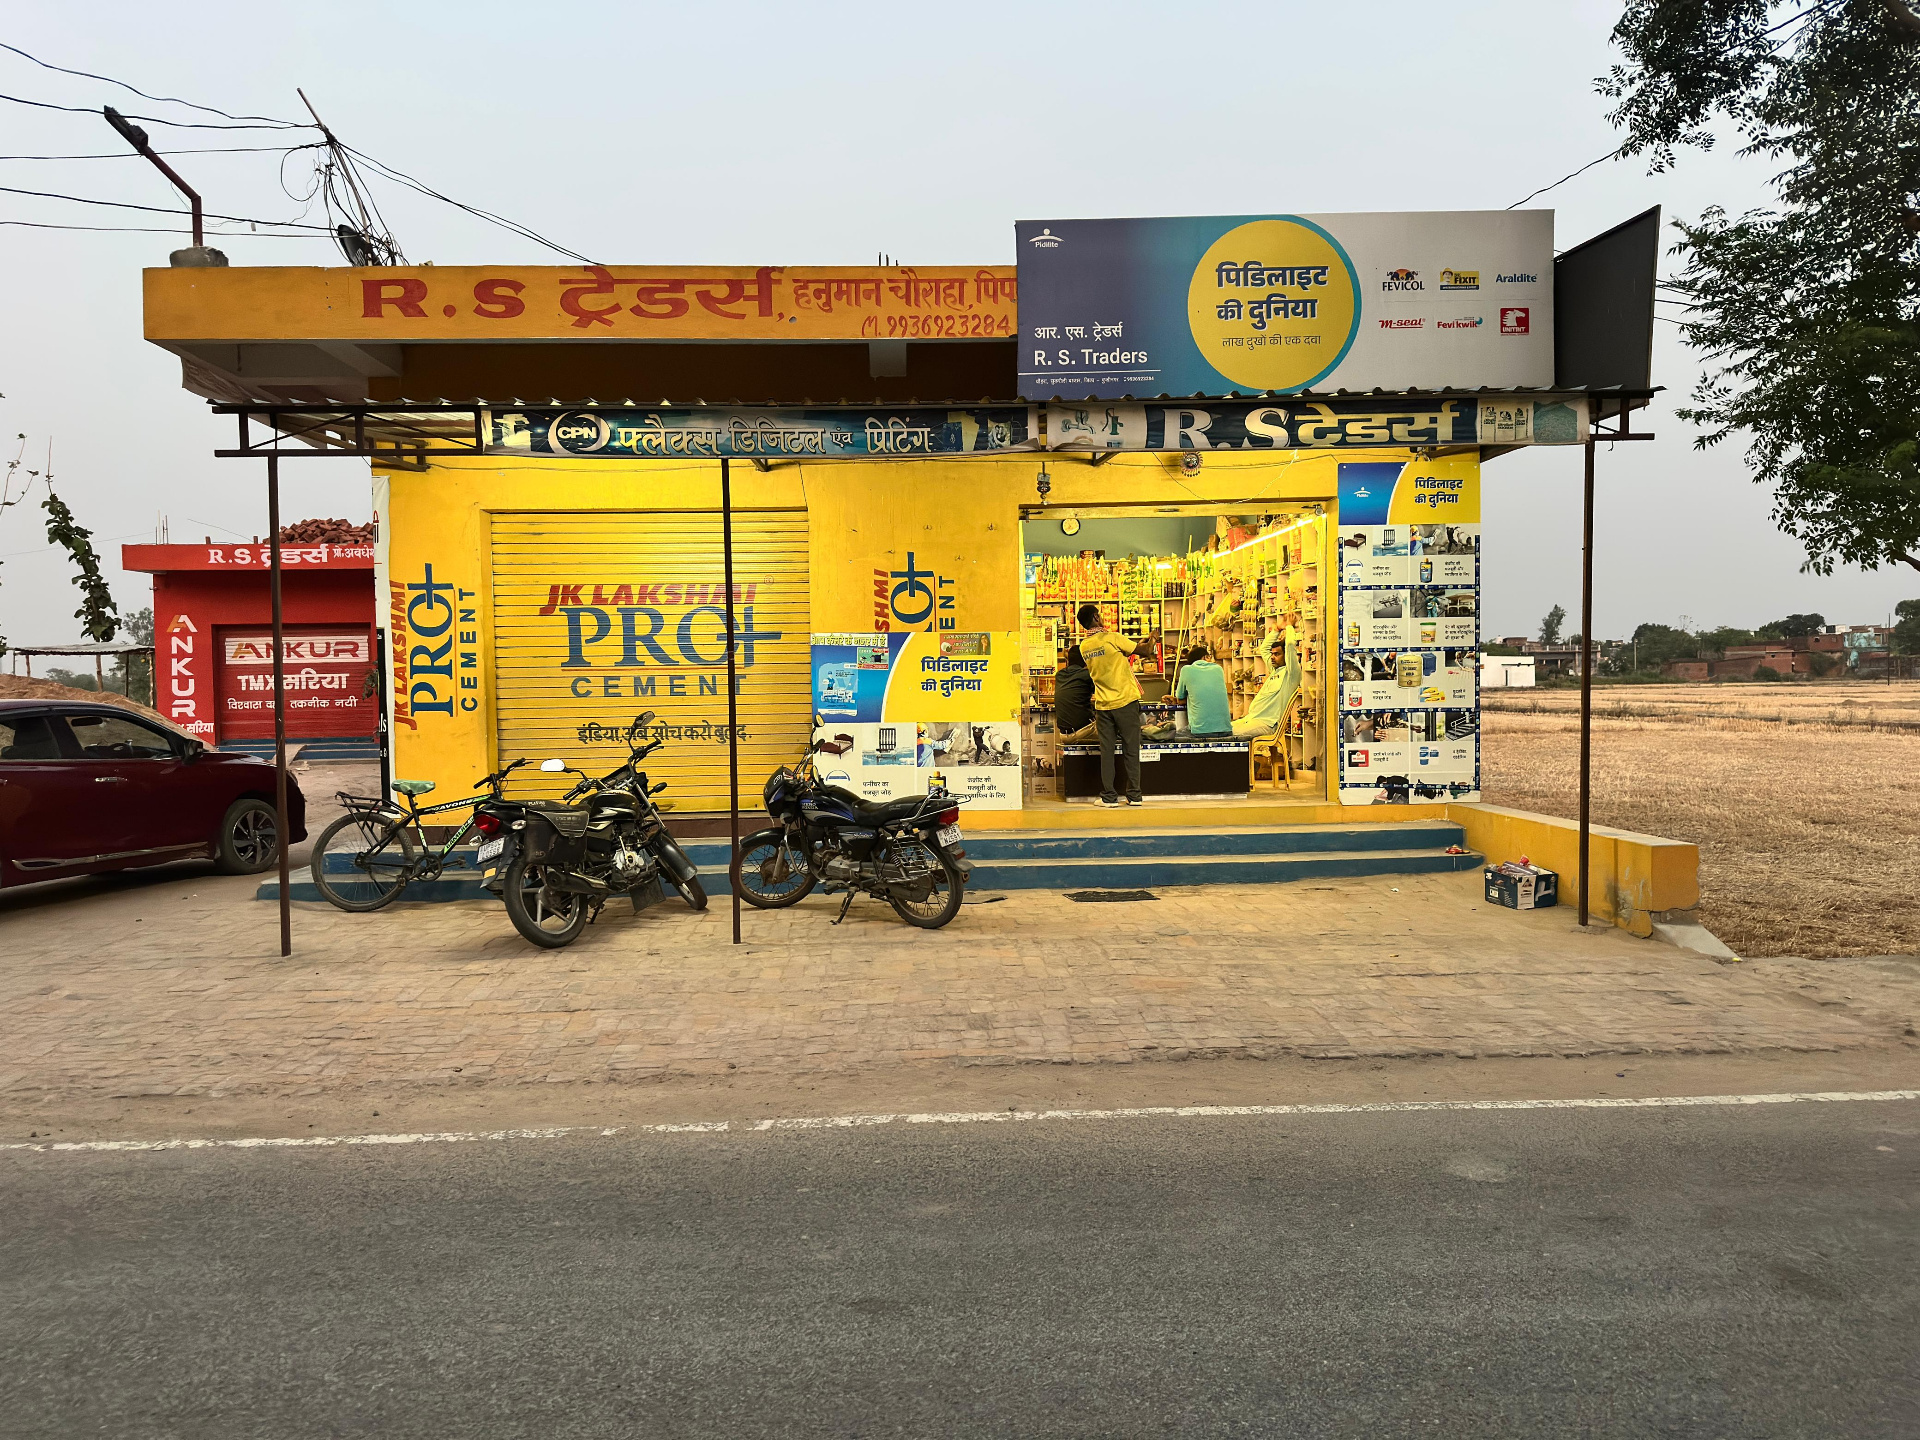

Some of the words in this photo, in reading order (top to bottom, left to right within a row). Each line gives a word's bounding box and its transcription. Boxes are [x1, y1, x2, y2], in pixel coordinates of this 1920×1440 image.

[1216, 261, 1329, 291] पिडिलाइट
[1382, 280, 1425, 292] FEVICOL
[1454, 276, 1477, 284] FIXIT
[1495, 273, 1536, 283] Araldite
[792, 278, 884, 313] हनुमान
[1216, 299, 1243, 321] की
[1248, 293, 1318, 330] दुनिया
[887, 314, 1011, 338] 9936923284
[1034, 326, 1061, 339] आर.
[1065, 325, 1088, 341] एस.
[1092, 321, 1123, 341] ट्रेडर्स
[1222, 336, 1244, 348] लाख
[1246, 334, 1267, 351] दुखों
[1269, 334, 1283, 346] की
[1284, 336, 1301, 346] एक
[1303, 335, 1321, 345] दवा
[1034, 350, 1052, 366] R.
[1058, 349, 1076, 366] S.
[1081, 348, 1148, 365] Traders
[557, 426, 598, 440] CPN
[728, 415, 826, 454] डिजिटल
[1414, 477, 1464, 491] पिडिलाइट
[1414, 494, 1427, 503] की
[1428, 491, 1459, 508] दुनिया
[538, 584, 585, 616] JK
[591, 583, 757, 606] LAKSHMI
[873, 568, 891, 632] SHMI
[938, 575, 956, 630] ENT
[231, 640, 360, 659] ANKUR
[389, 579, 409, 700] LAKSHMI
[458, 588, 478, 712] CEMENT
[166, 614, 198, 718] ANKUR
[920, 655, 989, 675] पिडिलाइट
[237, 674, 275, 691] TMX
[282, 667, 350, 690] सरिया
[571, 674, 747, 698] CEMENT
[920, 678, 937, 693] की
[940, 676, 983, 697] दुनिया
[289, 696, 330, 708] तकनीक
[334, 695, 359, 708] नयी
[186, 720, 214, 734] सरिया
[650, 720, 682, 741] सोच
[684, 720, 714, 741] करो
